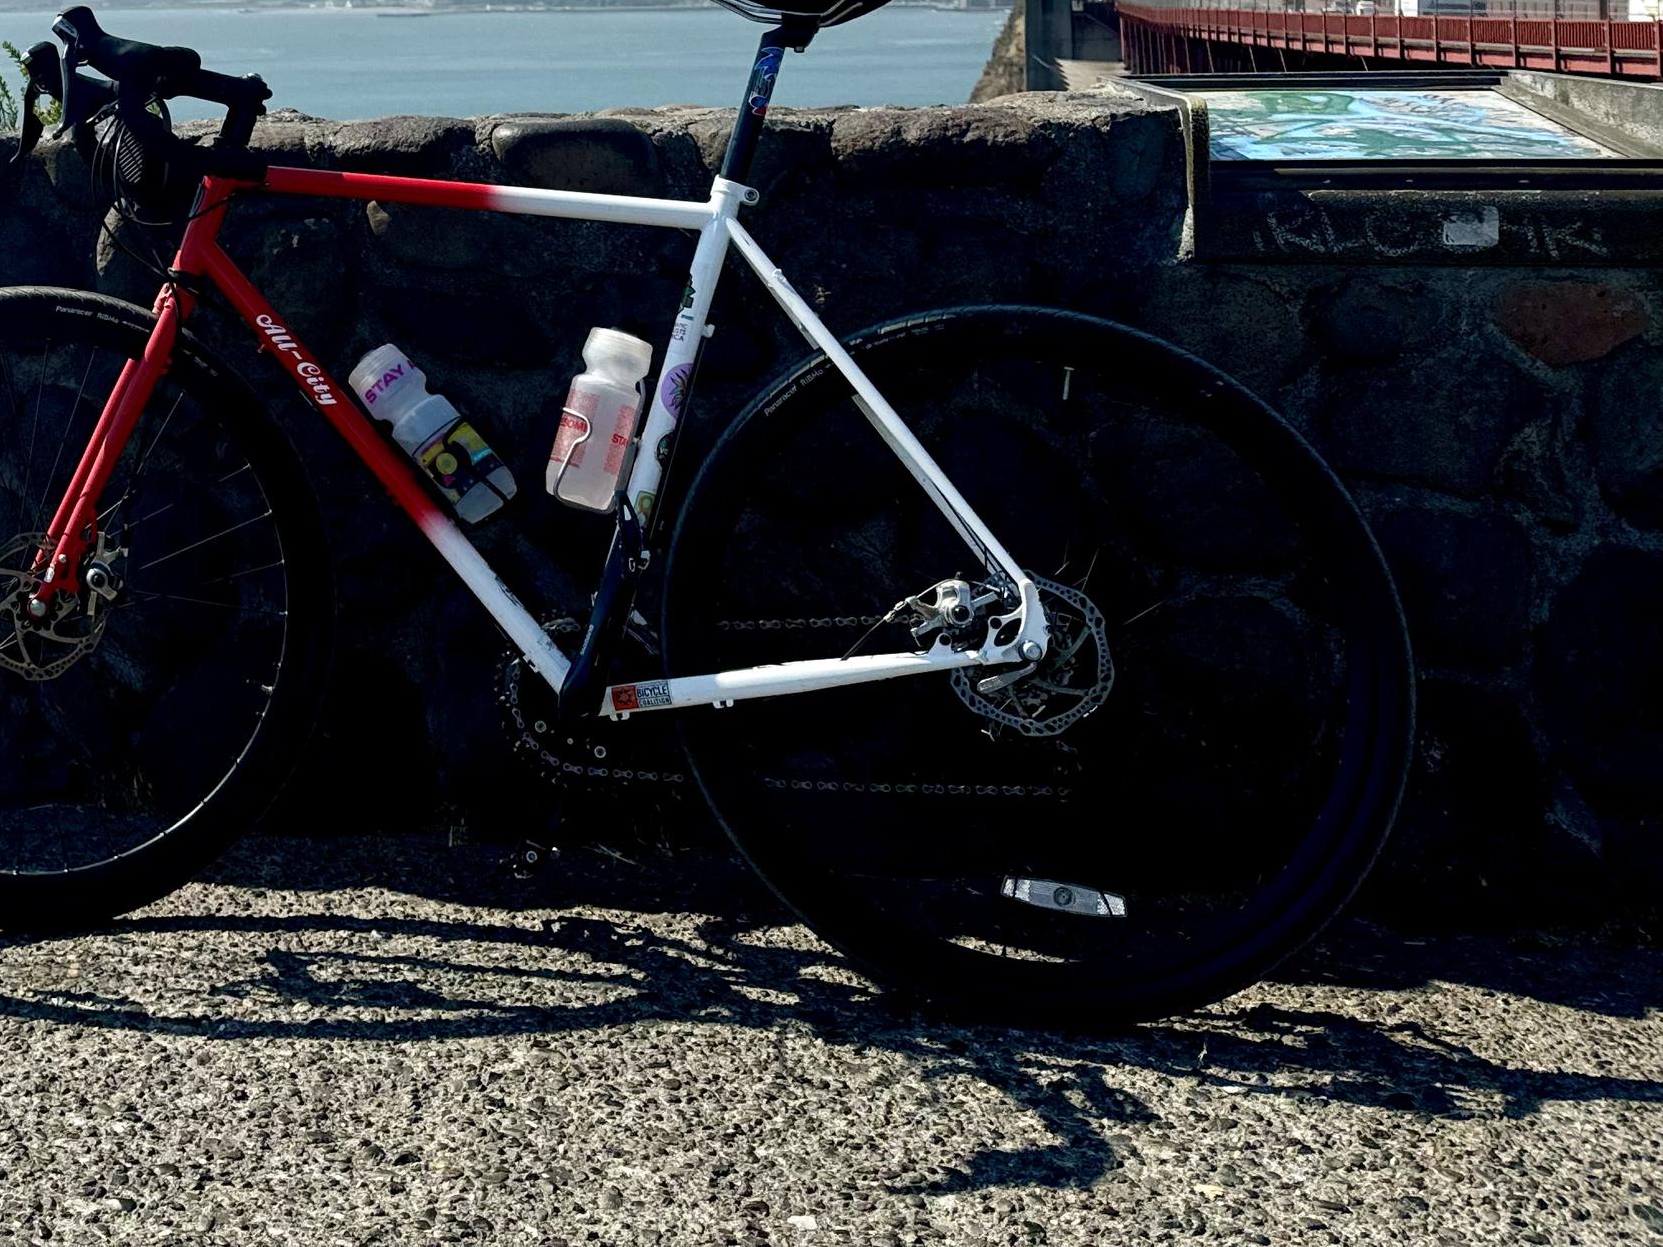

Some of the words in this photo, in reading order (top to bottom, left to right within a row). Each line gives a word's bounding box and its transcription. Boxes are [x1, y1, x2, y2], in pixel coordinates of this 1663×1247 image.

[256, 314, 337, 405] All-City
[365, 364, 404, 404] STAY
[637, 685, 667, 698] BICYCLE
